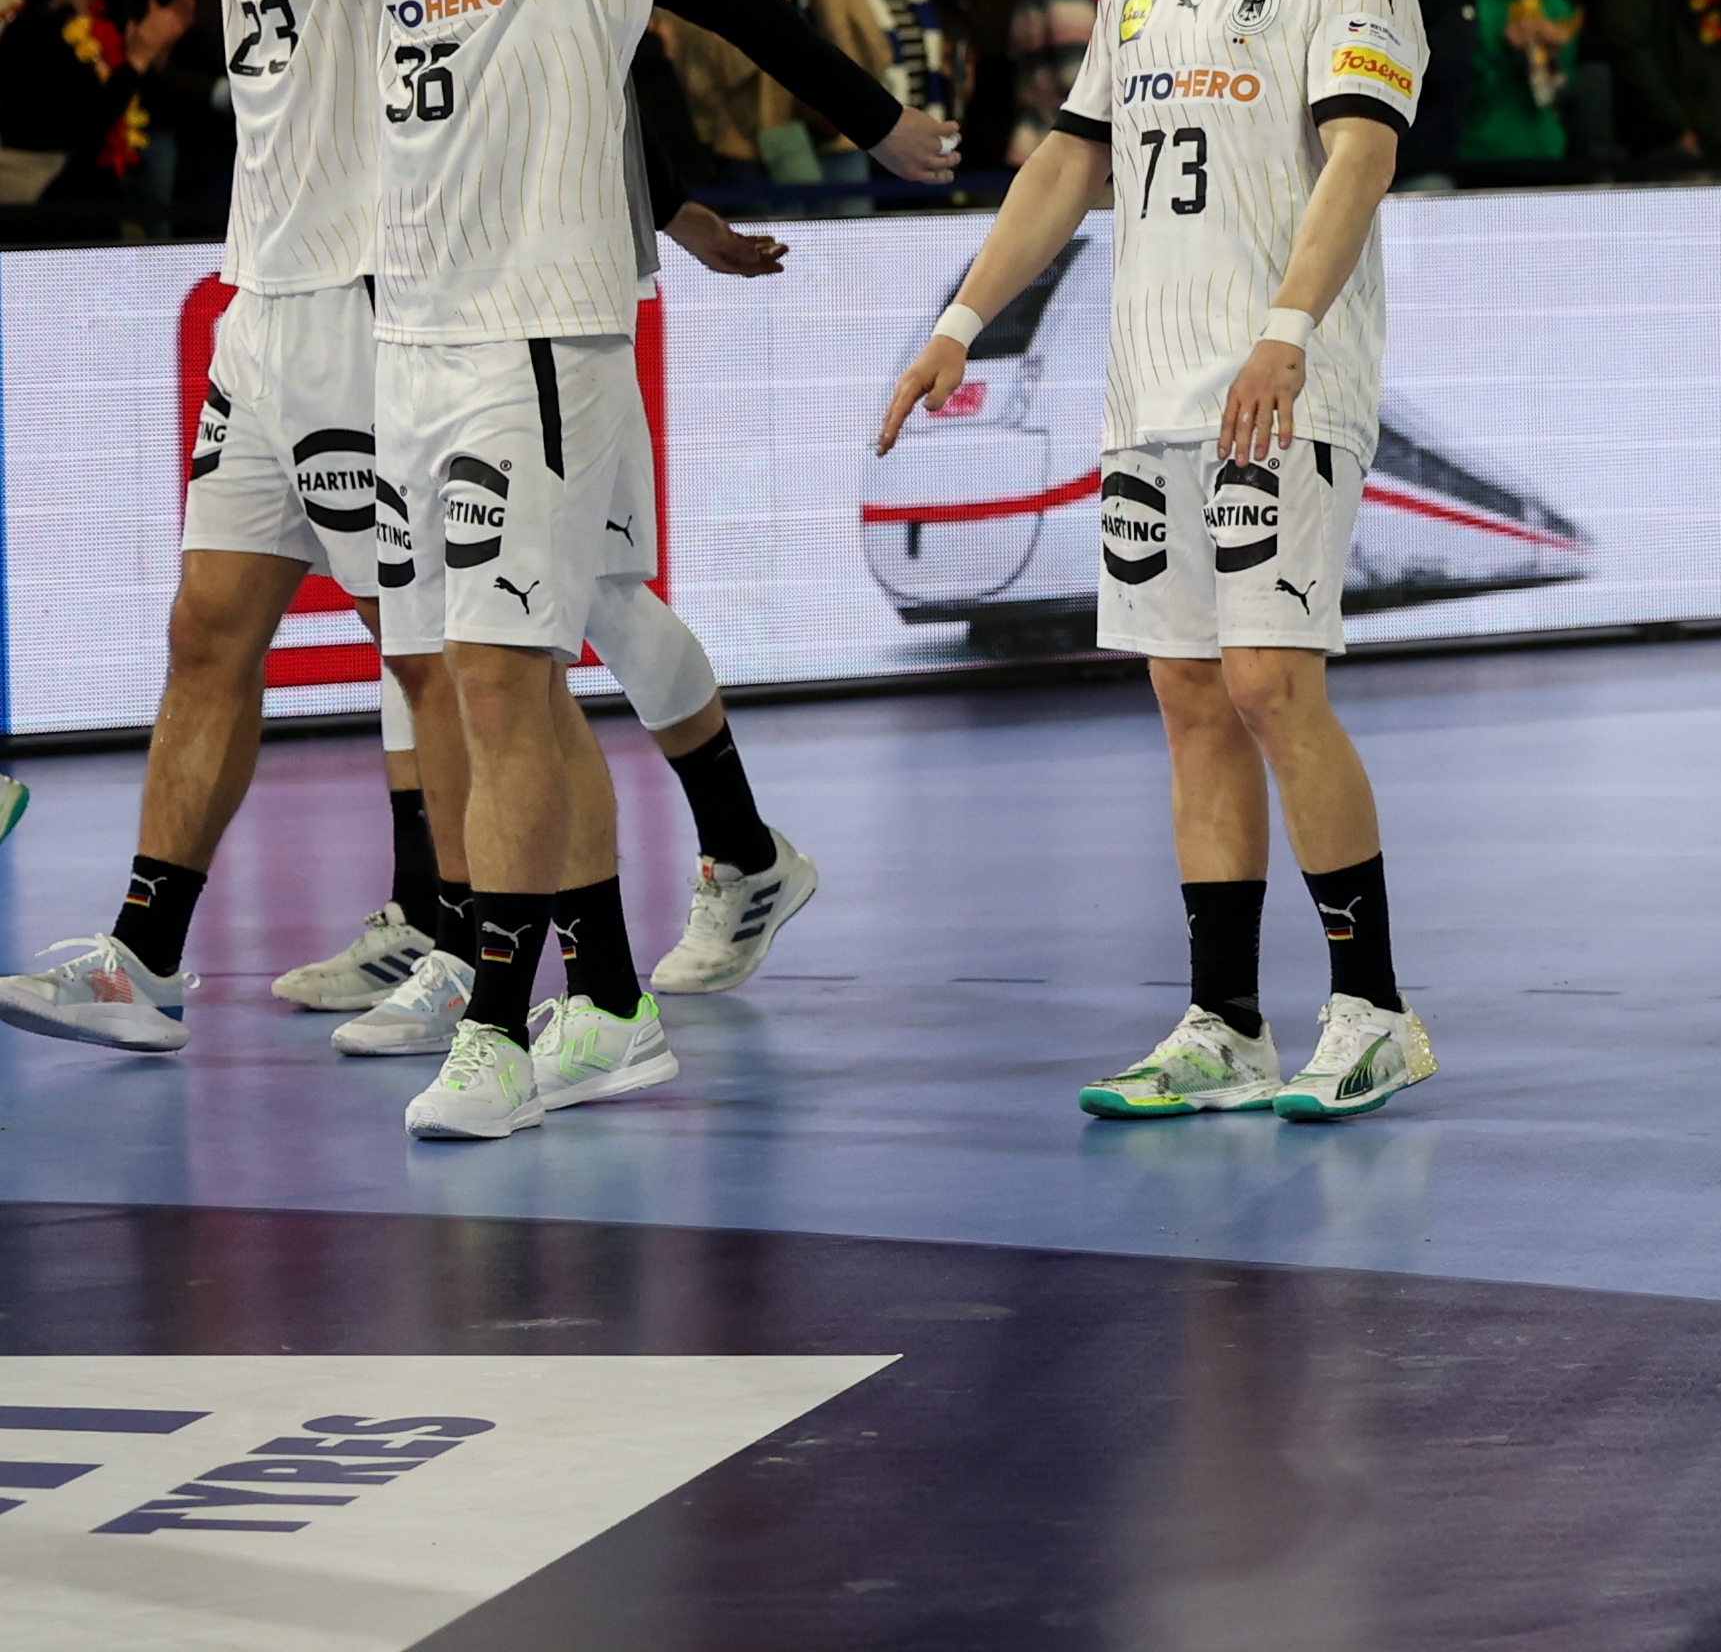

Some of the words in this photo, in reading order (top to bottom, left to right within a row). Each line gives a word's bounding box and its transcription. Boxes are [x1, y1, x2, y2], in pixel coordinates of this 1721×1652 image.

[385, 42, 461, 125] 36
[1123, 68, 1261, 104] UTOHERO
[1332, 50, 1413, 95] Josera
[1141, 127, 1207, 219] 73
[297, 468, 375, 492] HARTIN
[1101, 512, 1167, 543] HARTING
[1203, 504, 1278, 529] HARTING
[88, 1415, 497, 1535] TYRES
